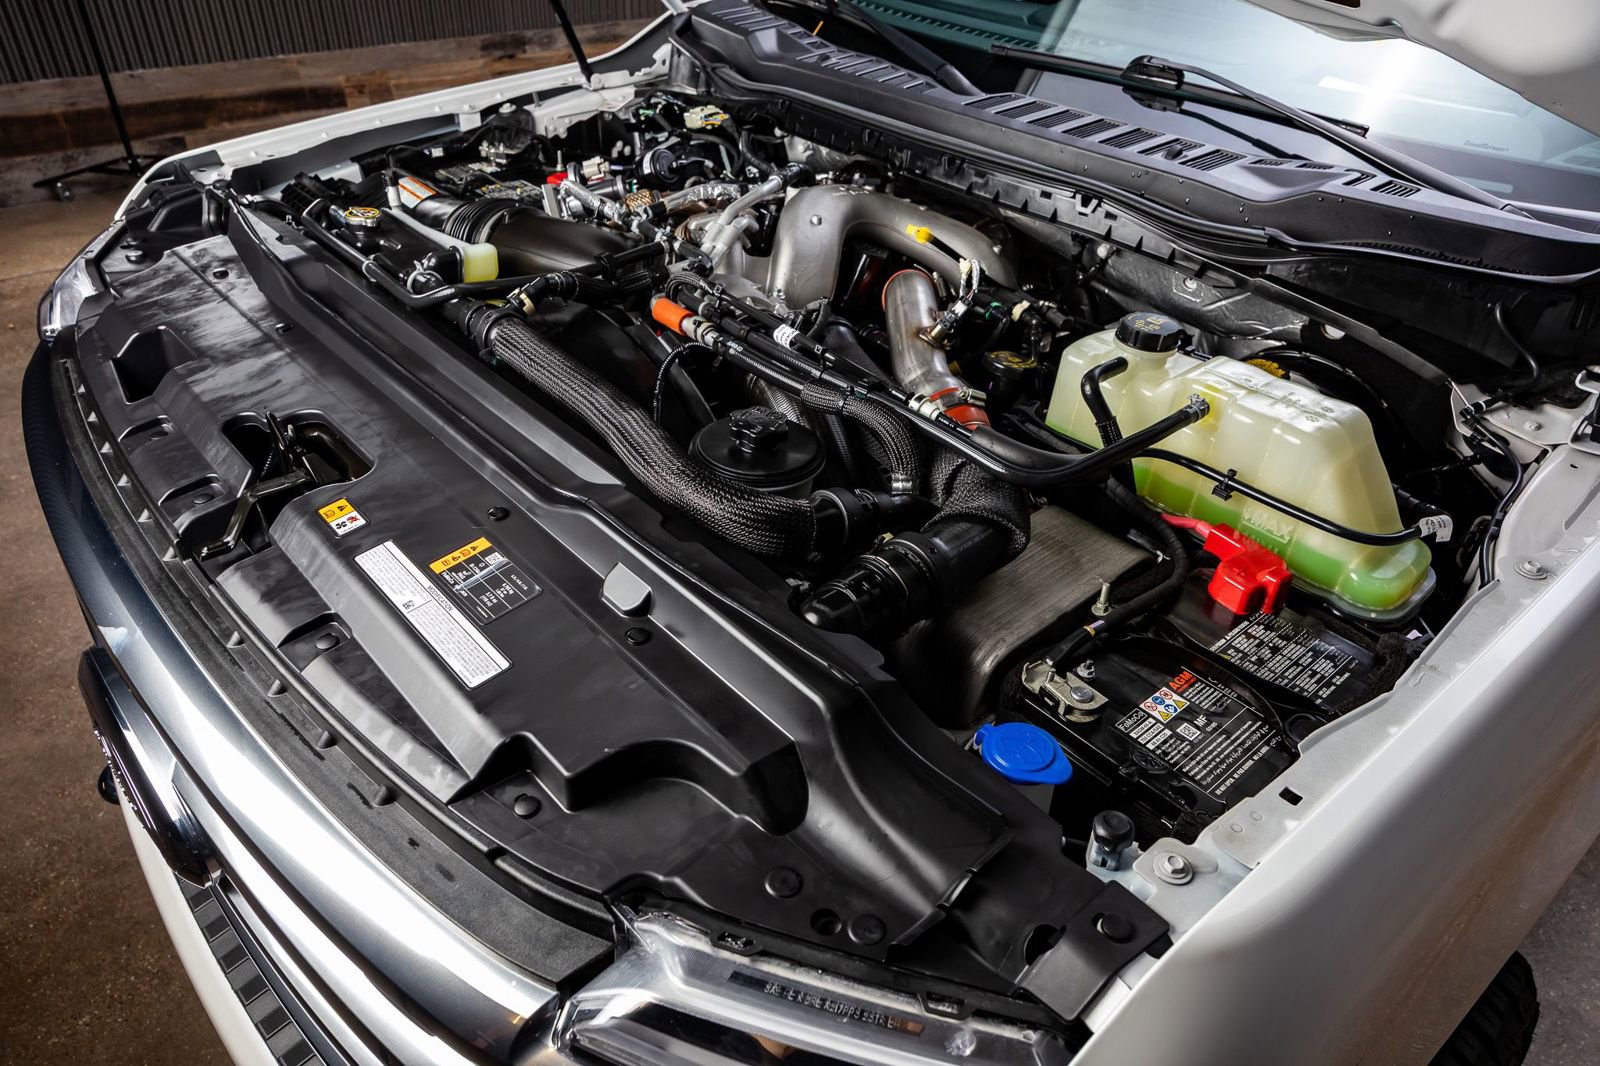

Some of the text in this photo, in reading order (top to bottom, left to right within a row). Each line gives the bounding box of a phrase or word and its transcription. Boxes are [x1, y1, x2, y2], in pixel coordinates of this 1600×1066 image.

[426, 585, 454, 612] MODIFICATION
[1168, 669, 1193, 691] AGM
[1118, 710, 1144, 731] FoMoCo
[1193, 714, 1209, 727] MF
